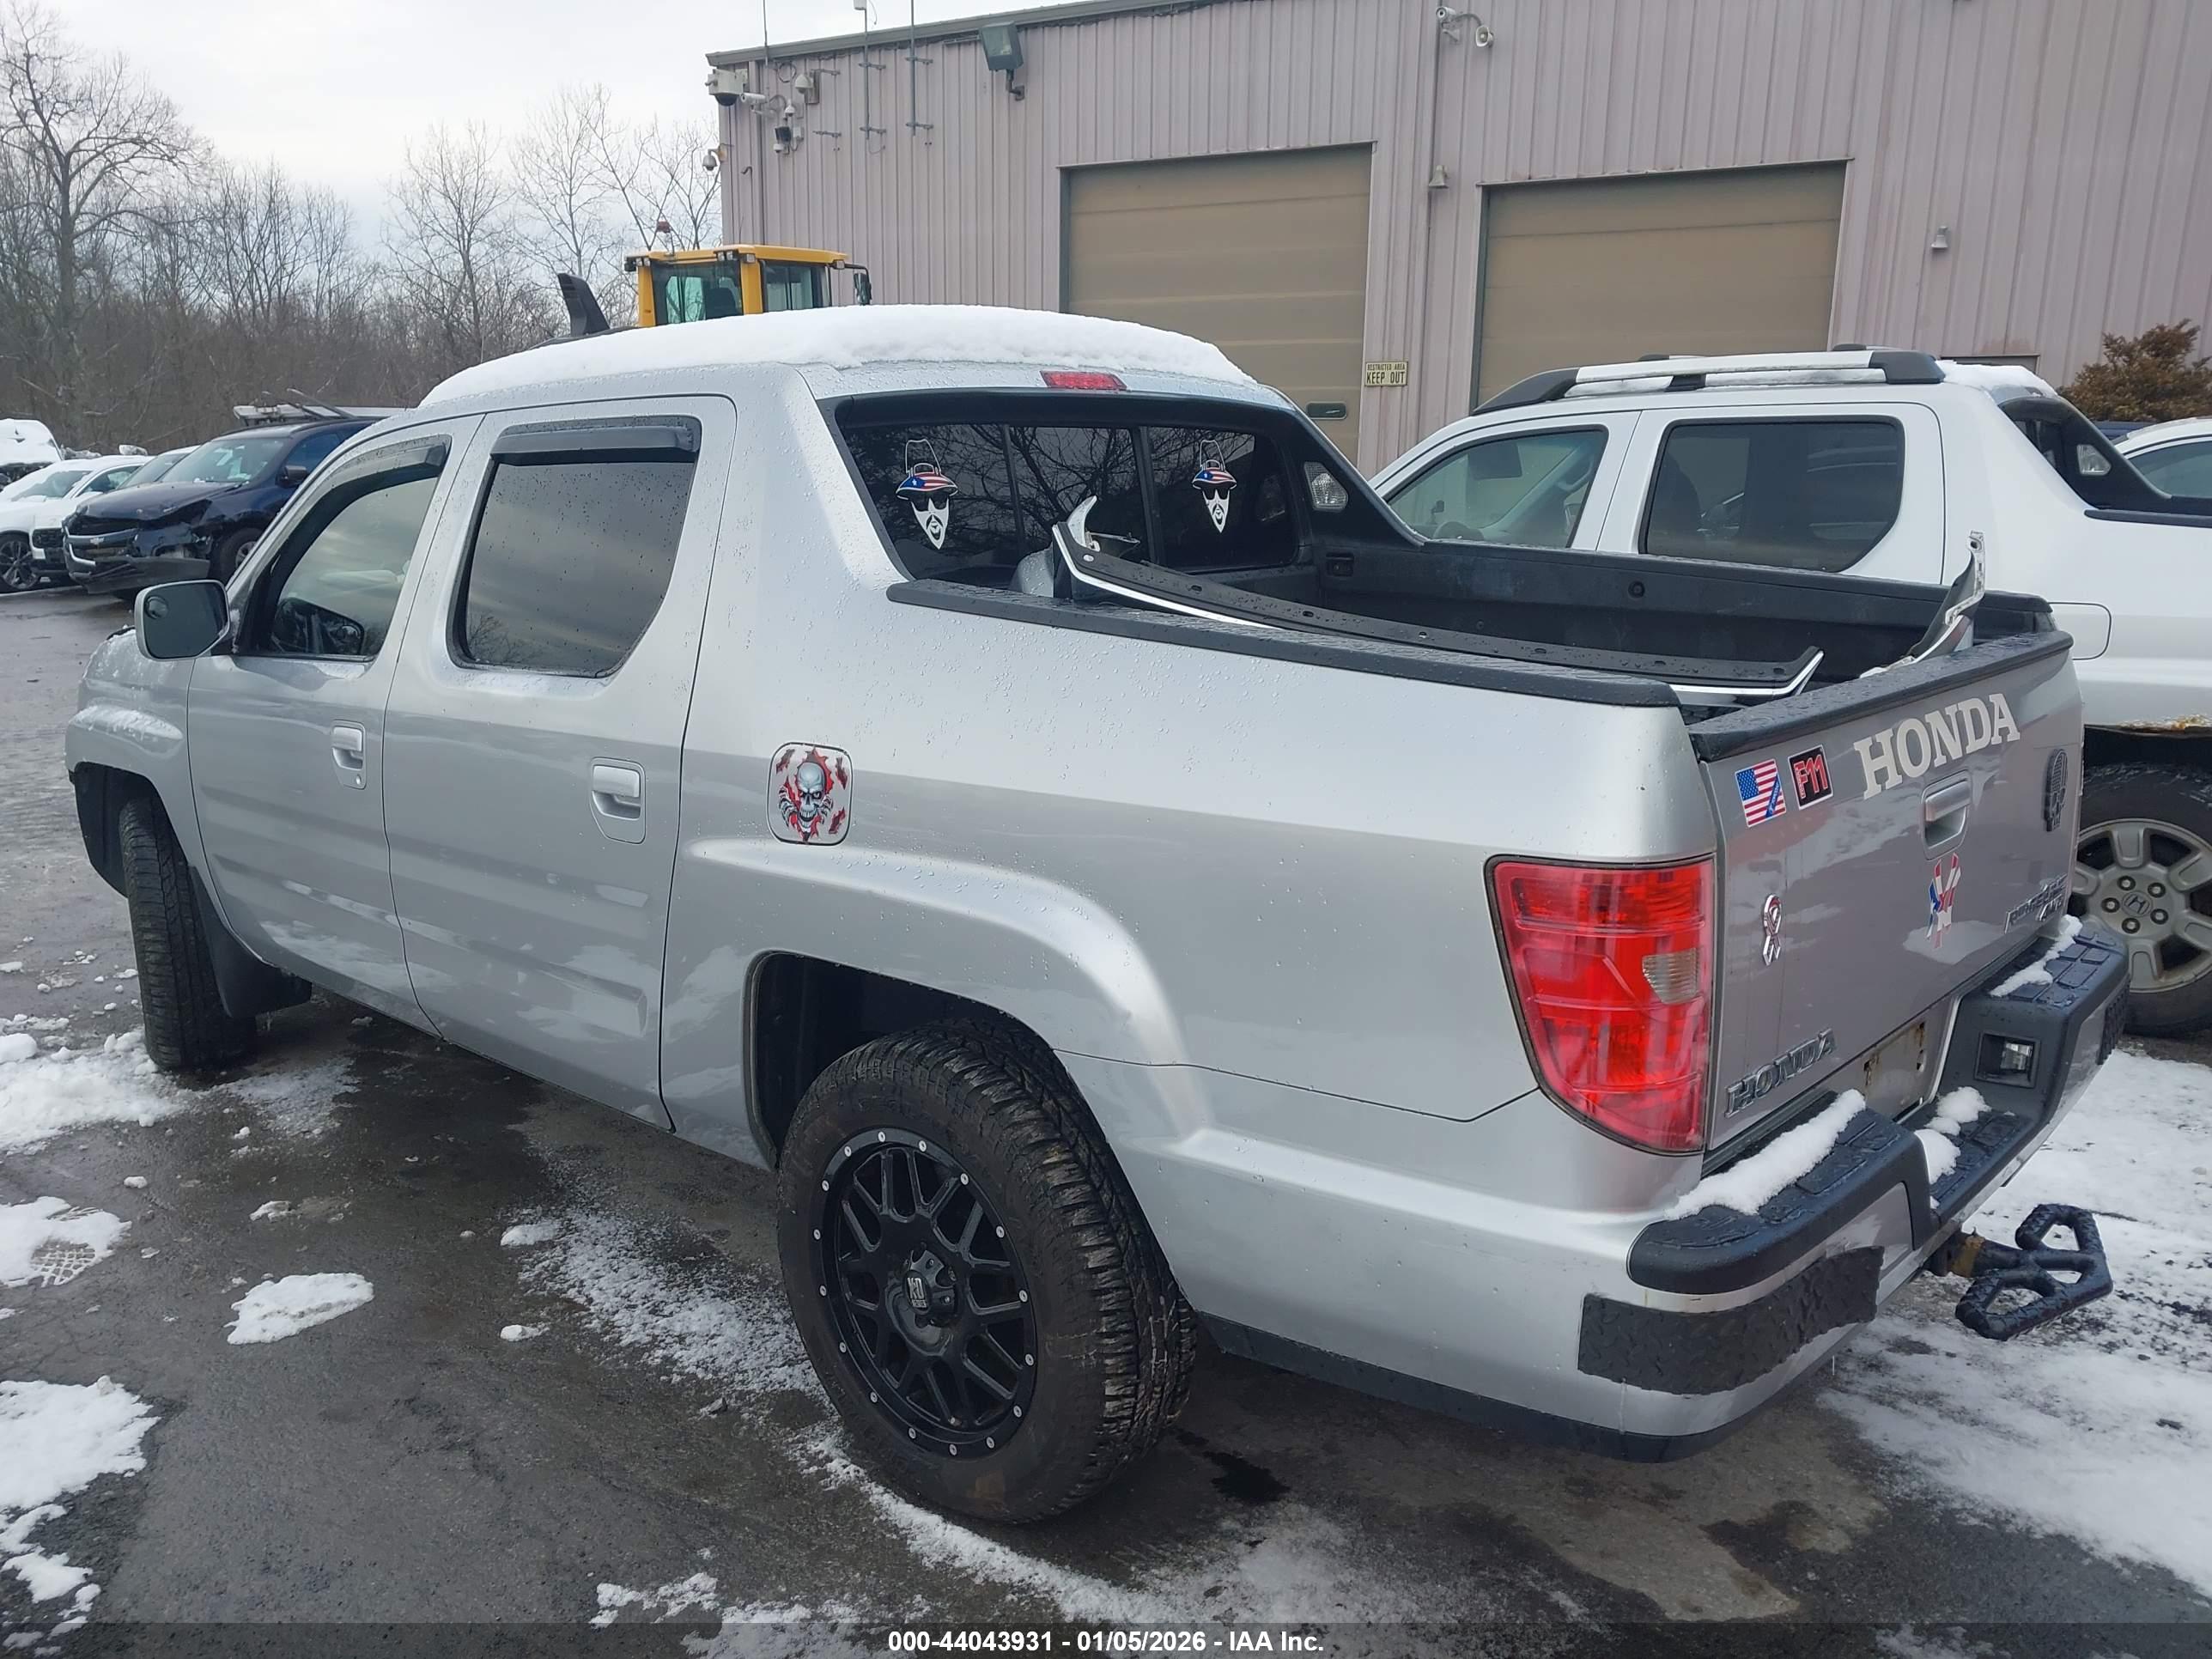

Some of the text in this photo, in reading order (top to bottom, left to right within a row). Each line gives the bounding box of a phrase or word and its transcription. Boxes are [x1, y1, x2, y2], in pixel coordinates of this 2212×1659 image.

[1366, 371, 1405, 384] KEEP OUT
[1853, 693, 2021, 799] HONDA
[1723, 1028, 1837, 1119] HONDA
